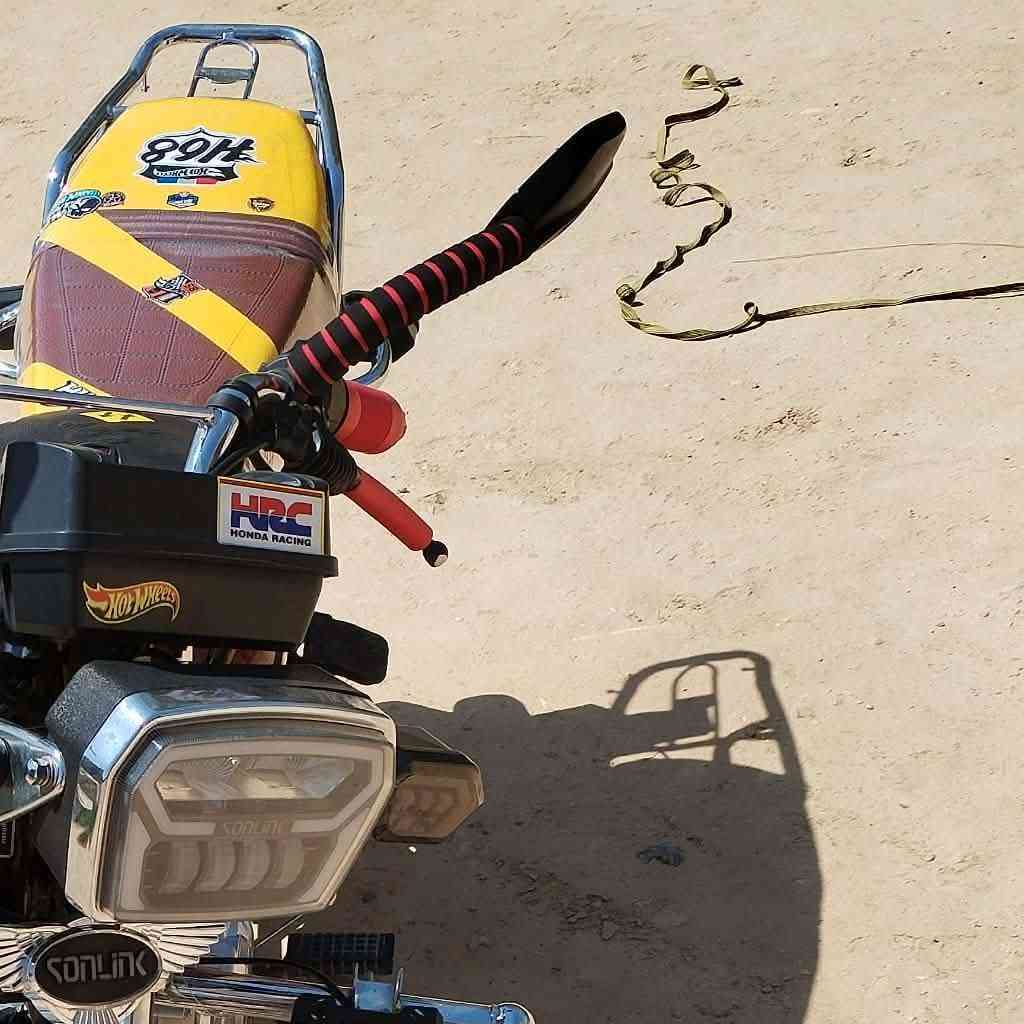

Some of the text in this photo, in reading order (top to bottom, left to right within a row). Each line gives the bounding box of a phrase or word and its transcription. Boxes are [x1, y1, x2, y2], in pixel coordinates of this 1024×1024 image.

[231, 493, 312, 537] HRC
[230, 529, 311, 546] HONDA RACING
